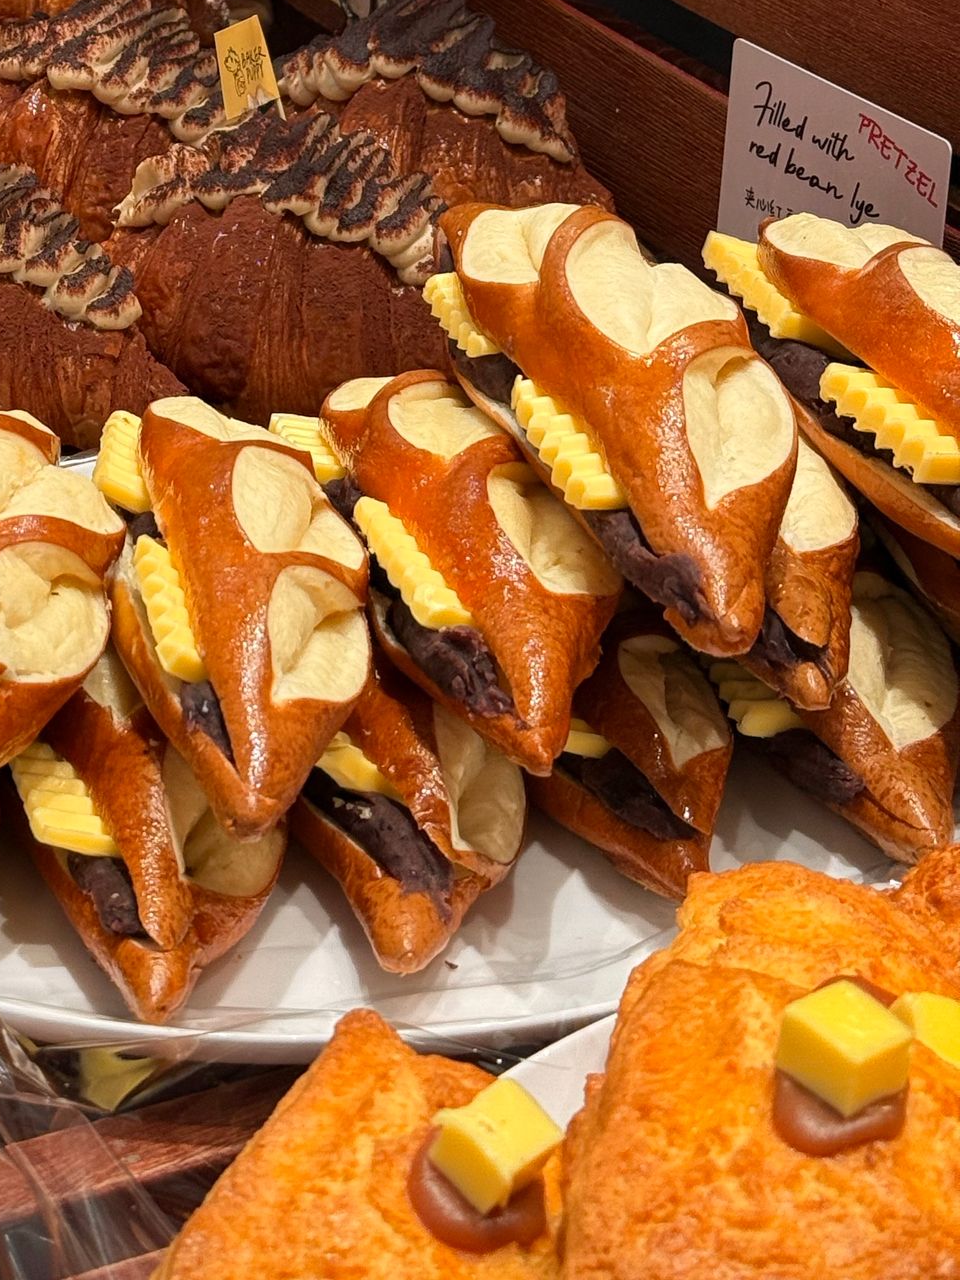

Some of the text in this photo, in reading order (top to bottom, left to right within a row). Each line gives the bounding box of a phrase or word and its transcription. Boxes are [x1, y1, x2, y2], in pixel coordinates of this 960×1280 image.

[754, 81, 855, 162] Filled with
[858, 113, 938, 208] PRETZEL
[745, 186, 793, 218] 夹心红
[749, 140, 880, 224] red bean lye
